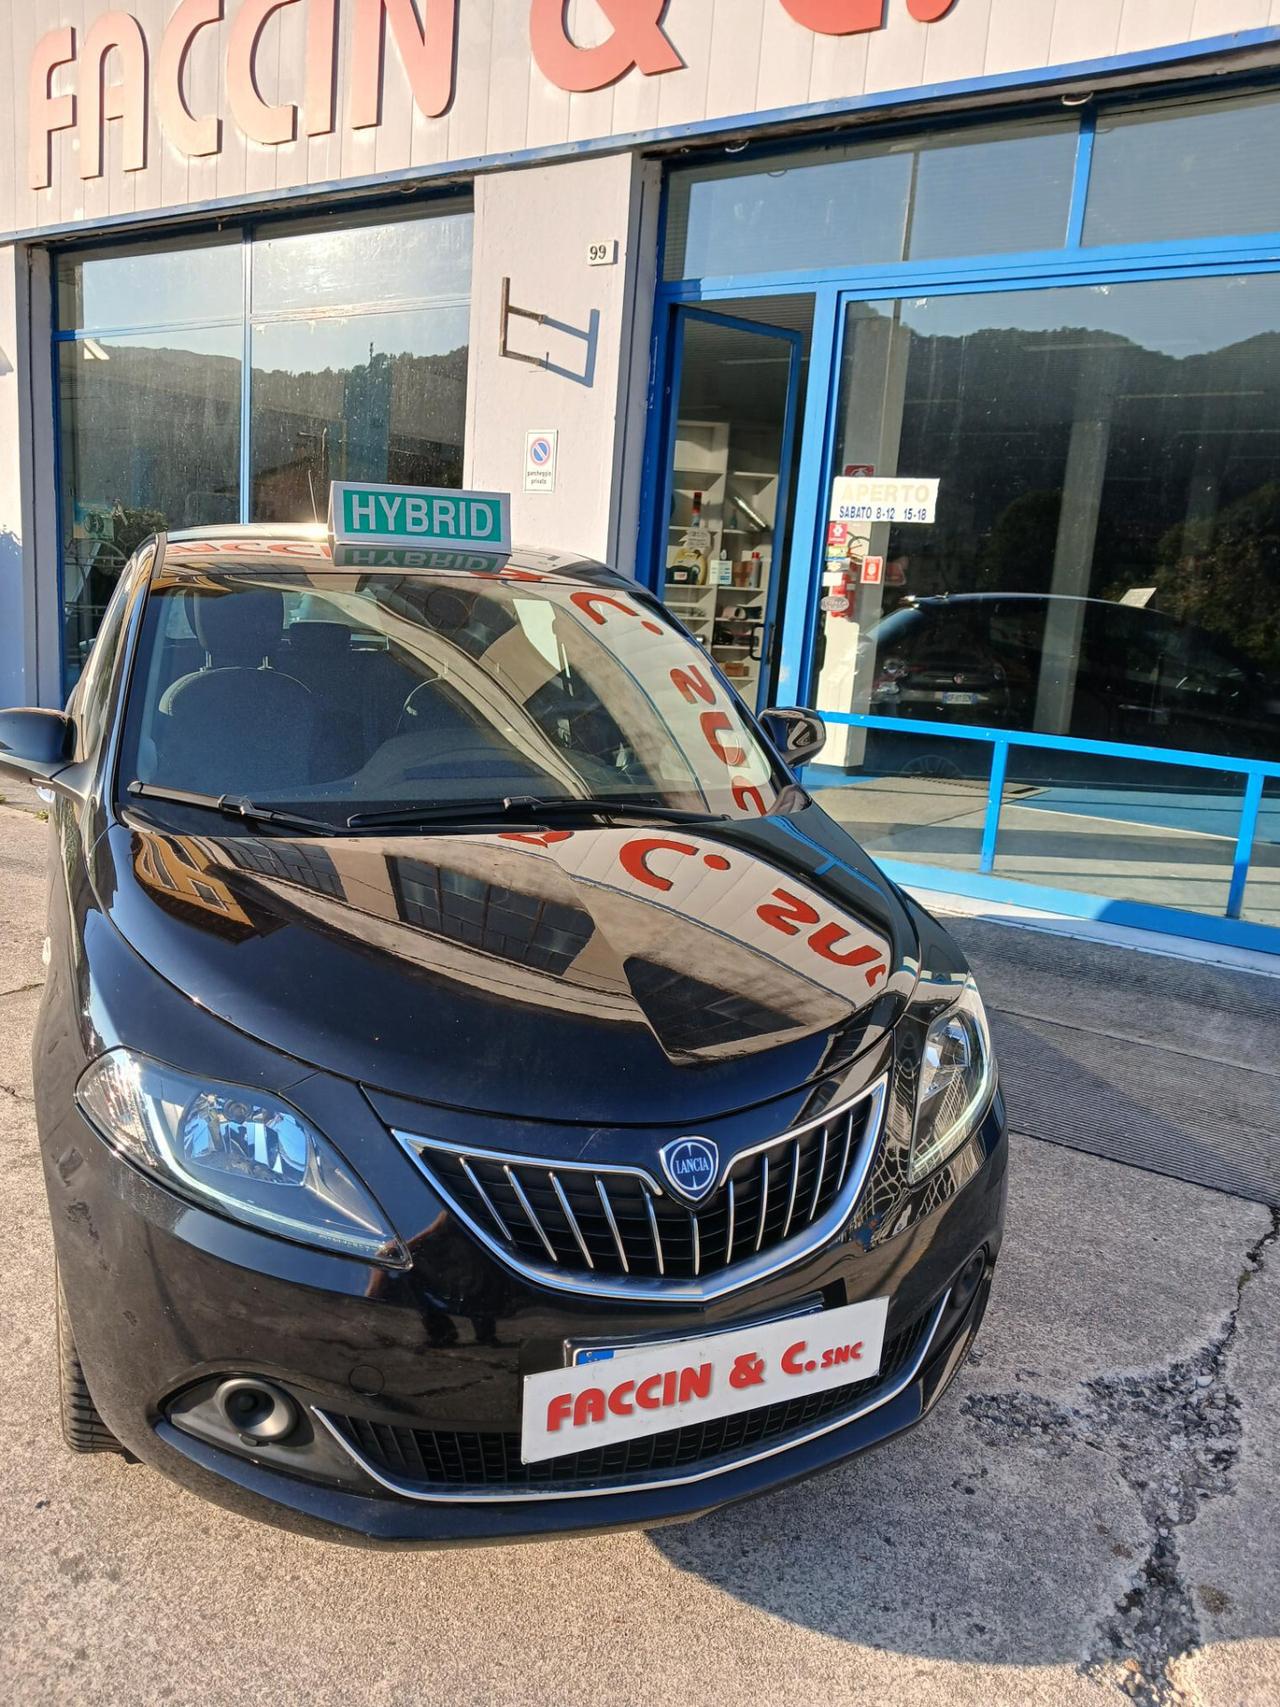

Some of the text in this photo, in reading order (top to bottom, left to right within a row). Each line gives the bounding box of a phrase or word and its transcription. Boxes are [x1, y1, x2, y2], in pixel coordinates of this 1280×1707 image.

[31, 0, 458, 190] FACCIN
[590, 245, 606, 260] 99
[842, 483, 930, 503] APERTO
[352, 494, 494, 537] HYBRID
[839, 505, 927, 520] SABATO 8-12 15-18
[675, 1157, 710, 1174] LANCIA
[546, 1362, 713, 1432] FACCIN
[729, 1352, 765, 1389] &
